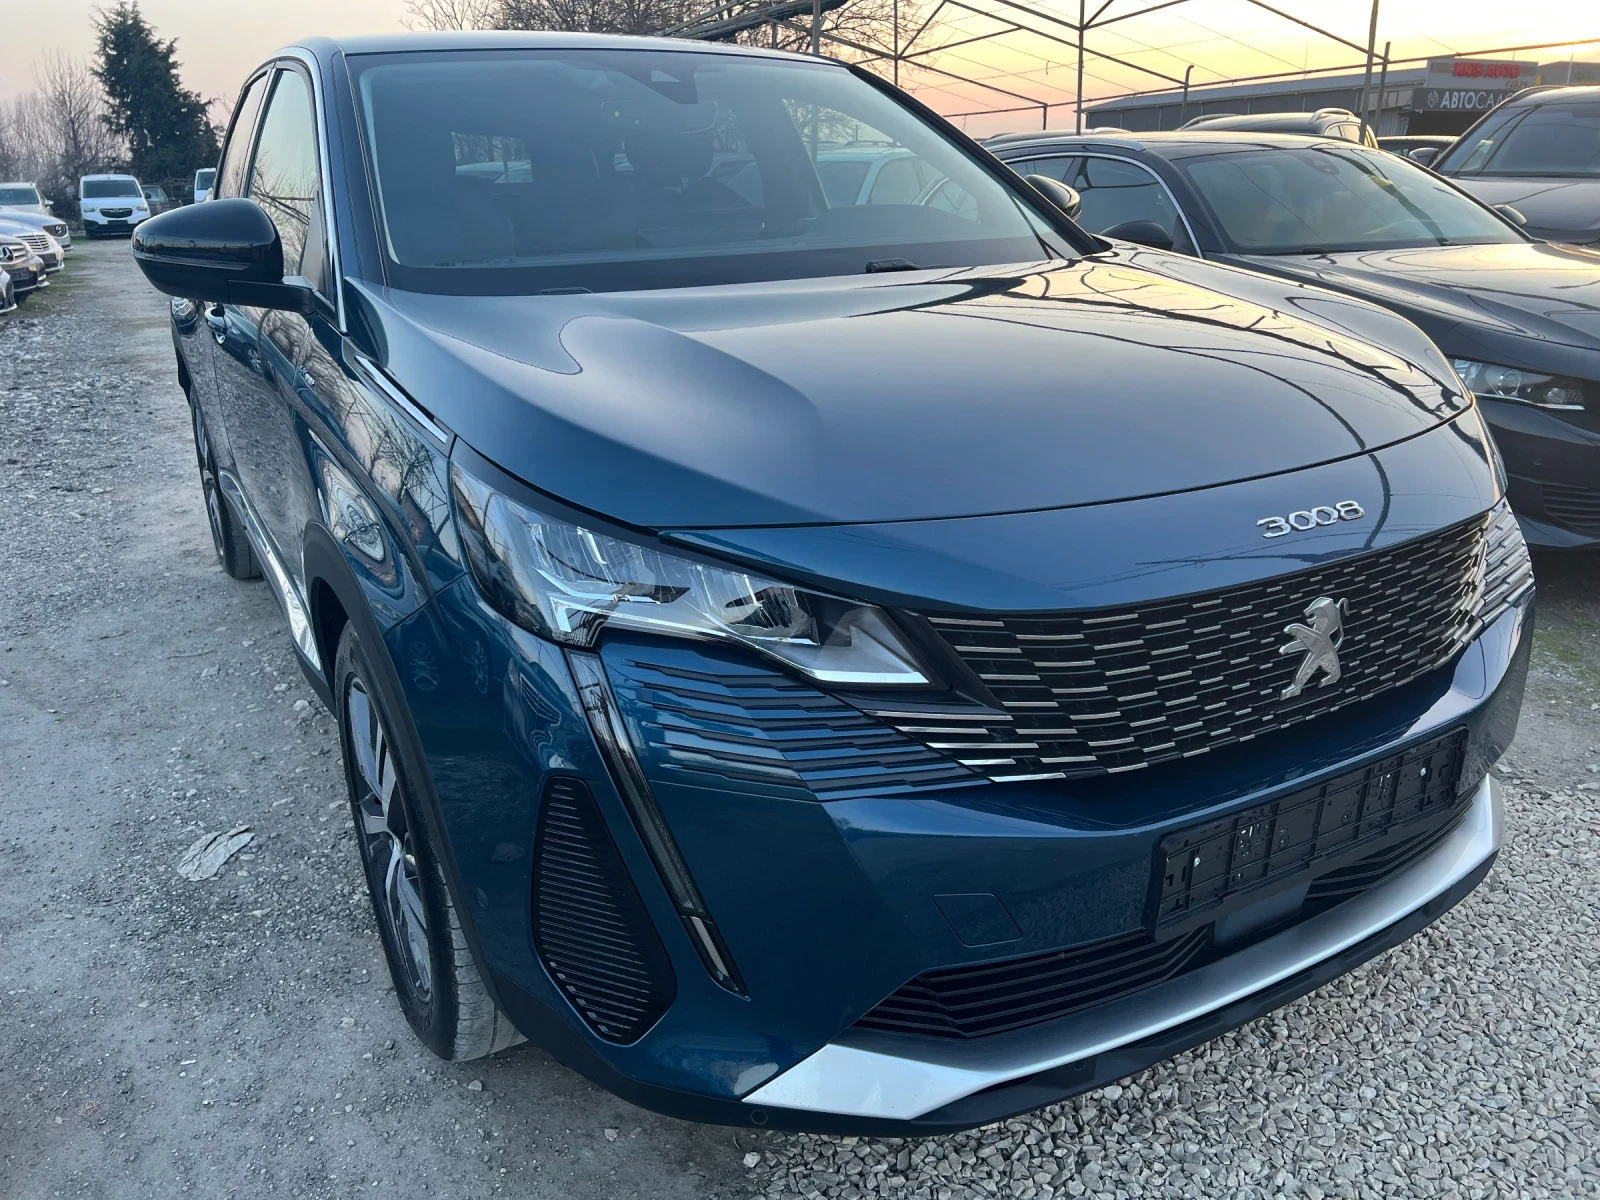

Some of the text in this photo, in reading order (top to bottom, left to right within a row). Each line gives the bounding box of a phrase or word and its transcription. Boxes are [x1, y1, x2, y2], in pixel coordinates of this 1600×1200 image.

[1485, 63, 1521, 78] AUTO
[1440, 91, 1513, 109] АВТОСАЛ
[1256, 500, 1365, 538] 3008
